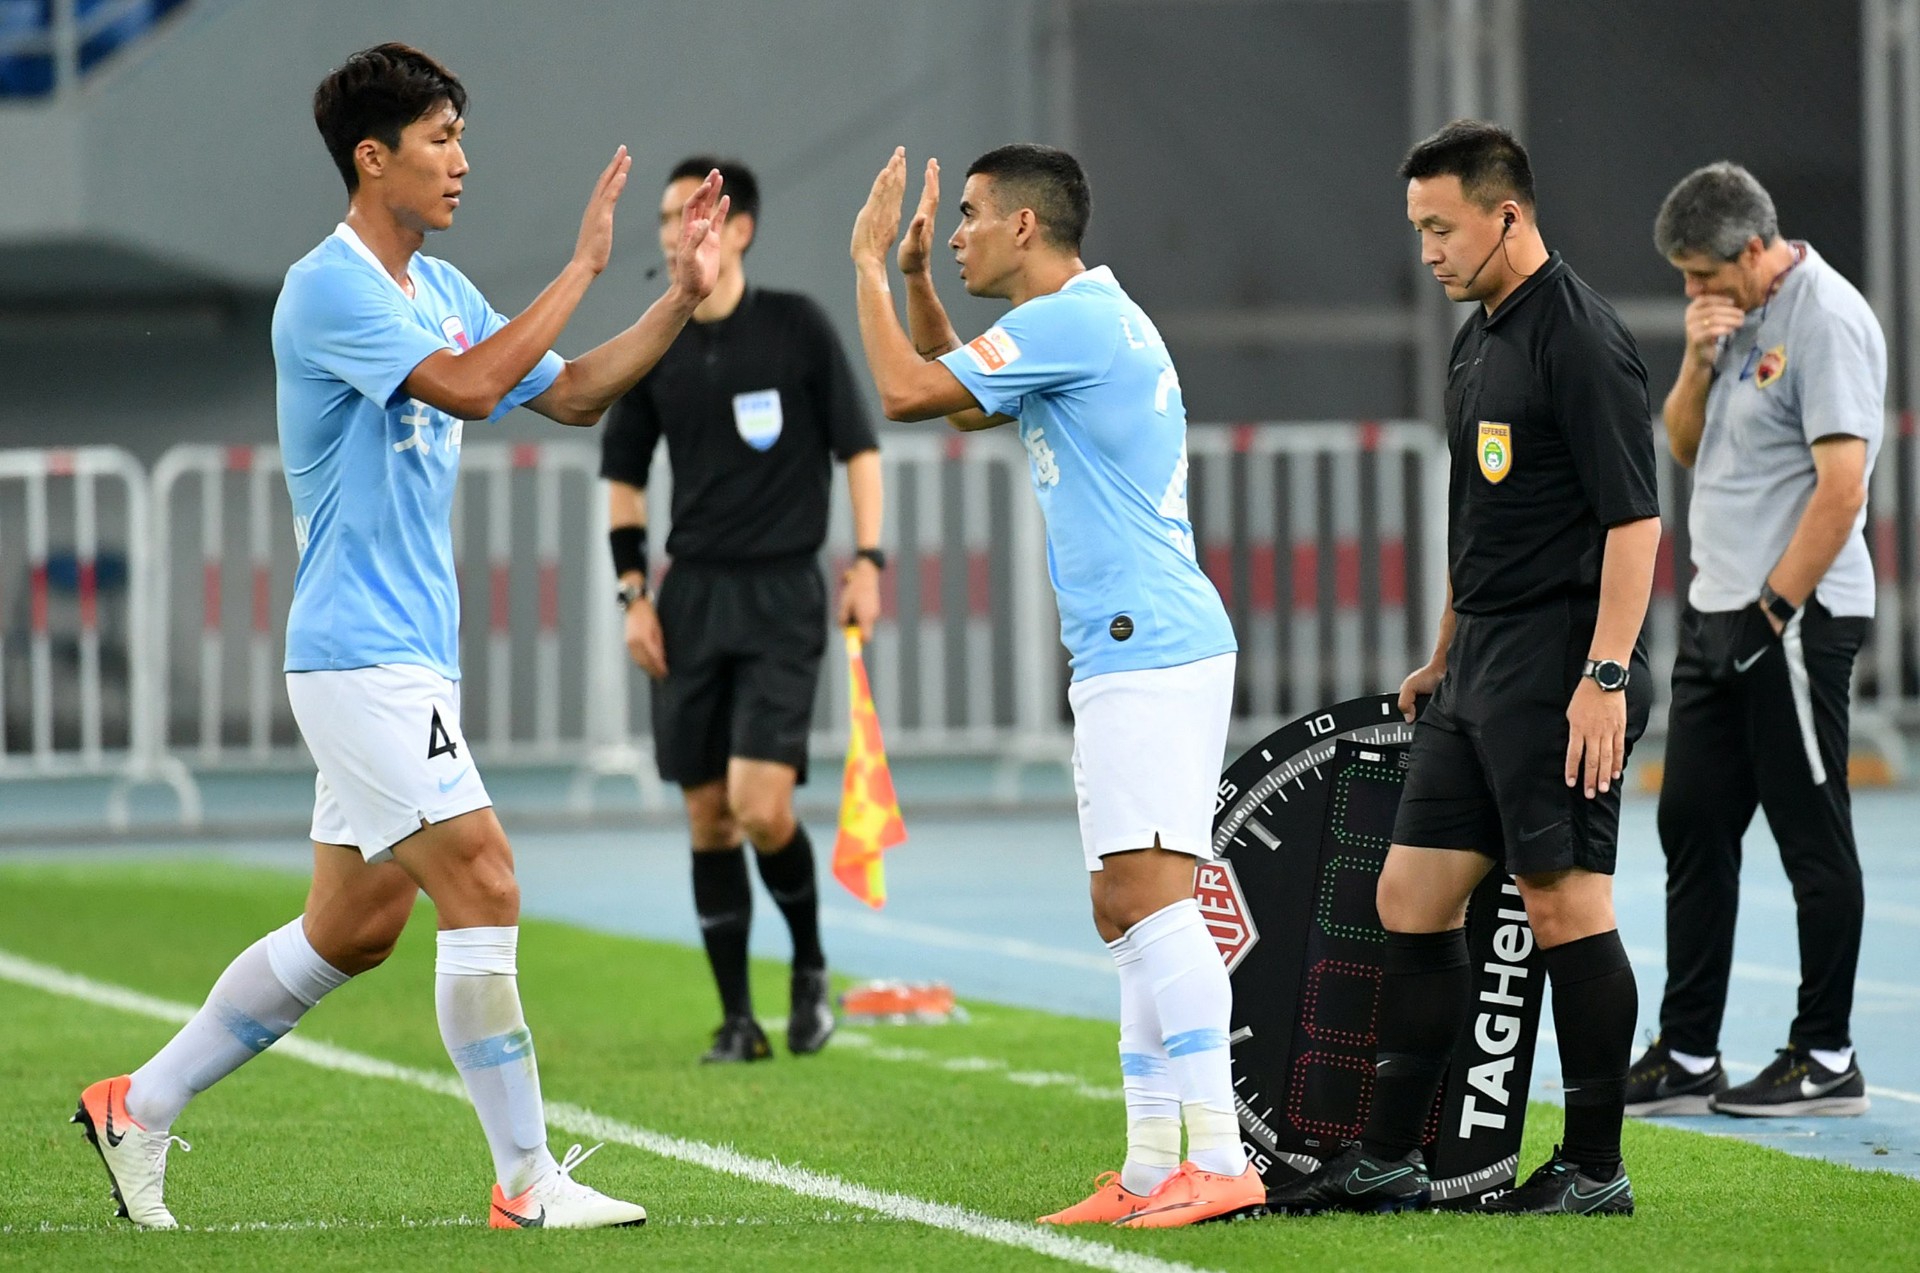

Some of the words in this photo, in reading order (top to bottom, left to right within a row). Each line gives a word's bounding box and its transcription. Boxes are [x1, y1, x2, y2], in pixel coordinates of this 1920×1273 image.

[1481, 427, 1507, 436] REFEREE
[427, 703, 458, 760] 4
[1305, 713, 1336, 738] 10
[1197, 869, 1245, 961] UER
